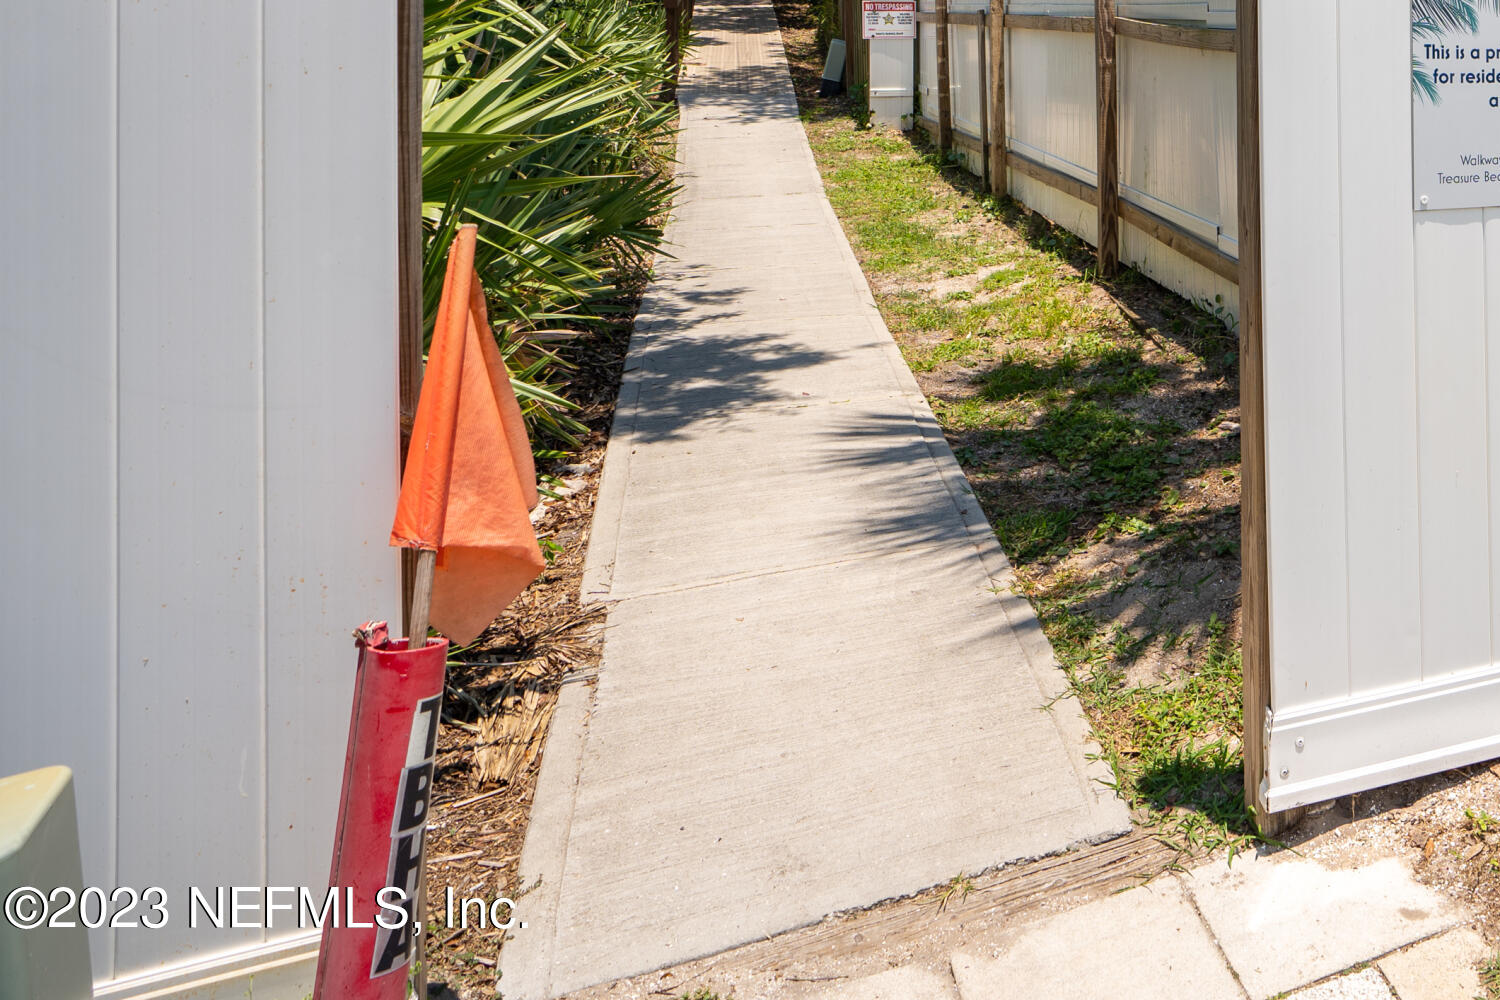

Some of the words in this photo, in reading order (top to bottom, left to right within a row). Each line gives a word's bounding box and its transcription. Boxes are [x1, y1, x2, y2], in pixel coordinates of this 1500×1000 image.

[1424, 44, 1450, 59] This
[1456, 45, 1464, 59] is
[1470, 48, 1480, 60] a
[1432, 68, 1454, 84] for
[1437, 173, 1480, 184] Treasure
